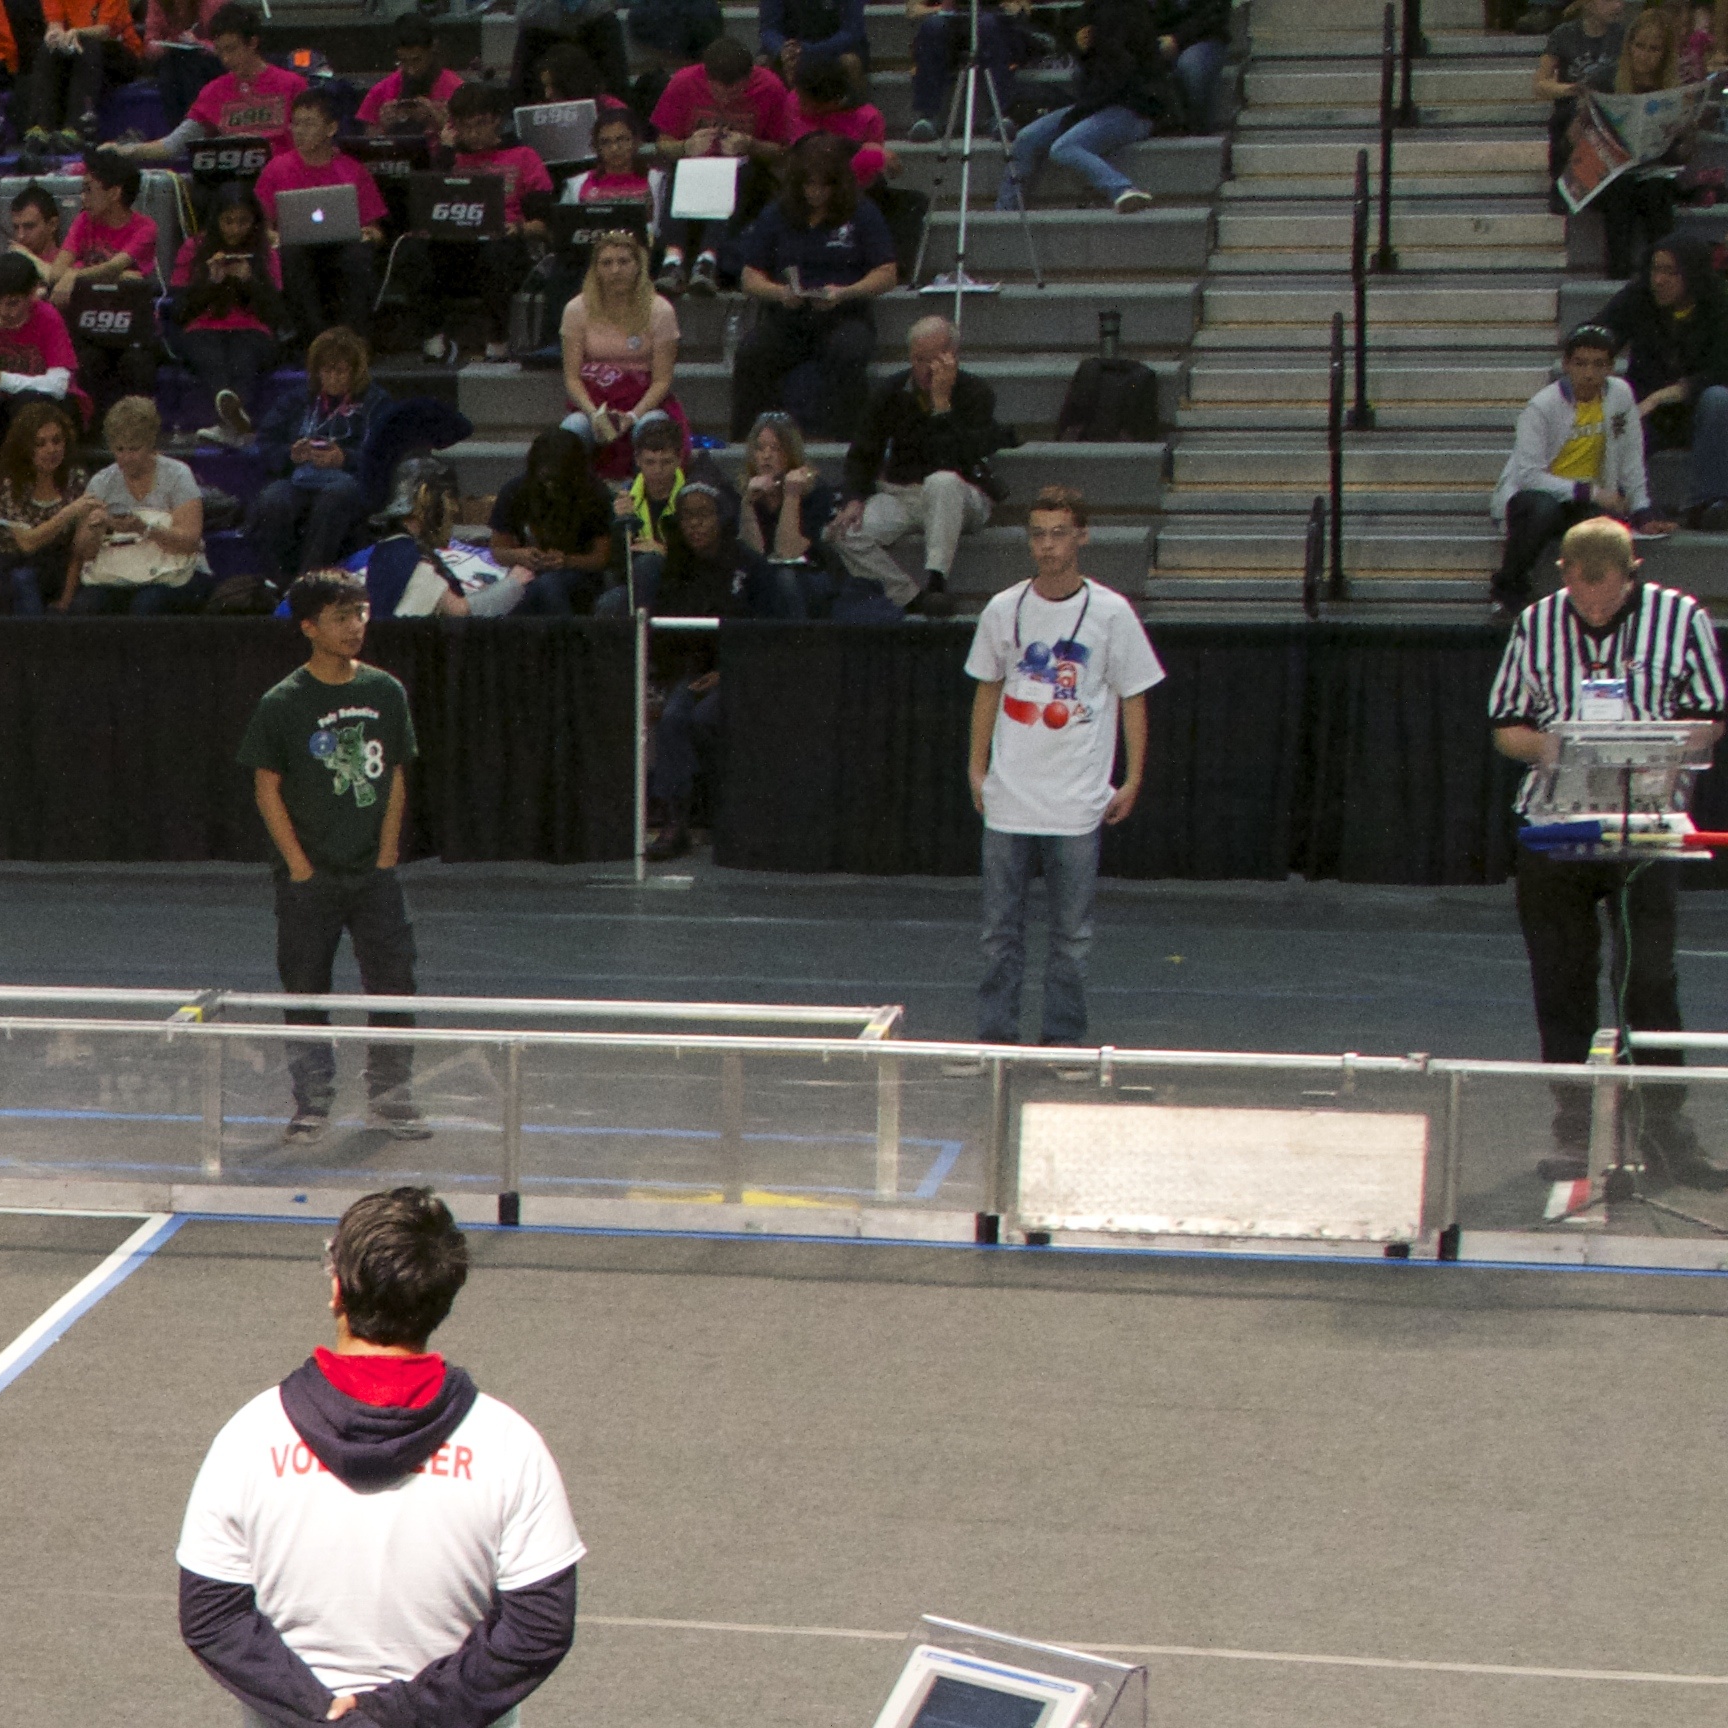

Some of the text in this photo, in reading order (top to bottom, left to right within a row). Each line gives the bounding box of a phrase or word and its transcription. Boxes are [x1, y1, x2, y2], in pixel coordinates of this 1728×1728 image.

[532, 108, 579, 127] 696
[192, 149, 267, 171] 696
[431, 202, 485, 222] 696
[78, 310, 132, 330] 696
